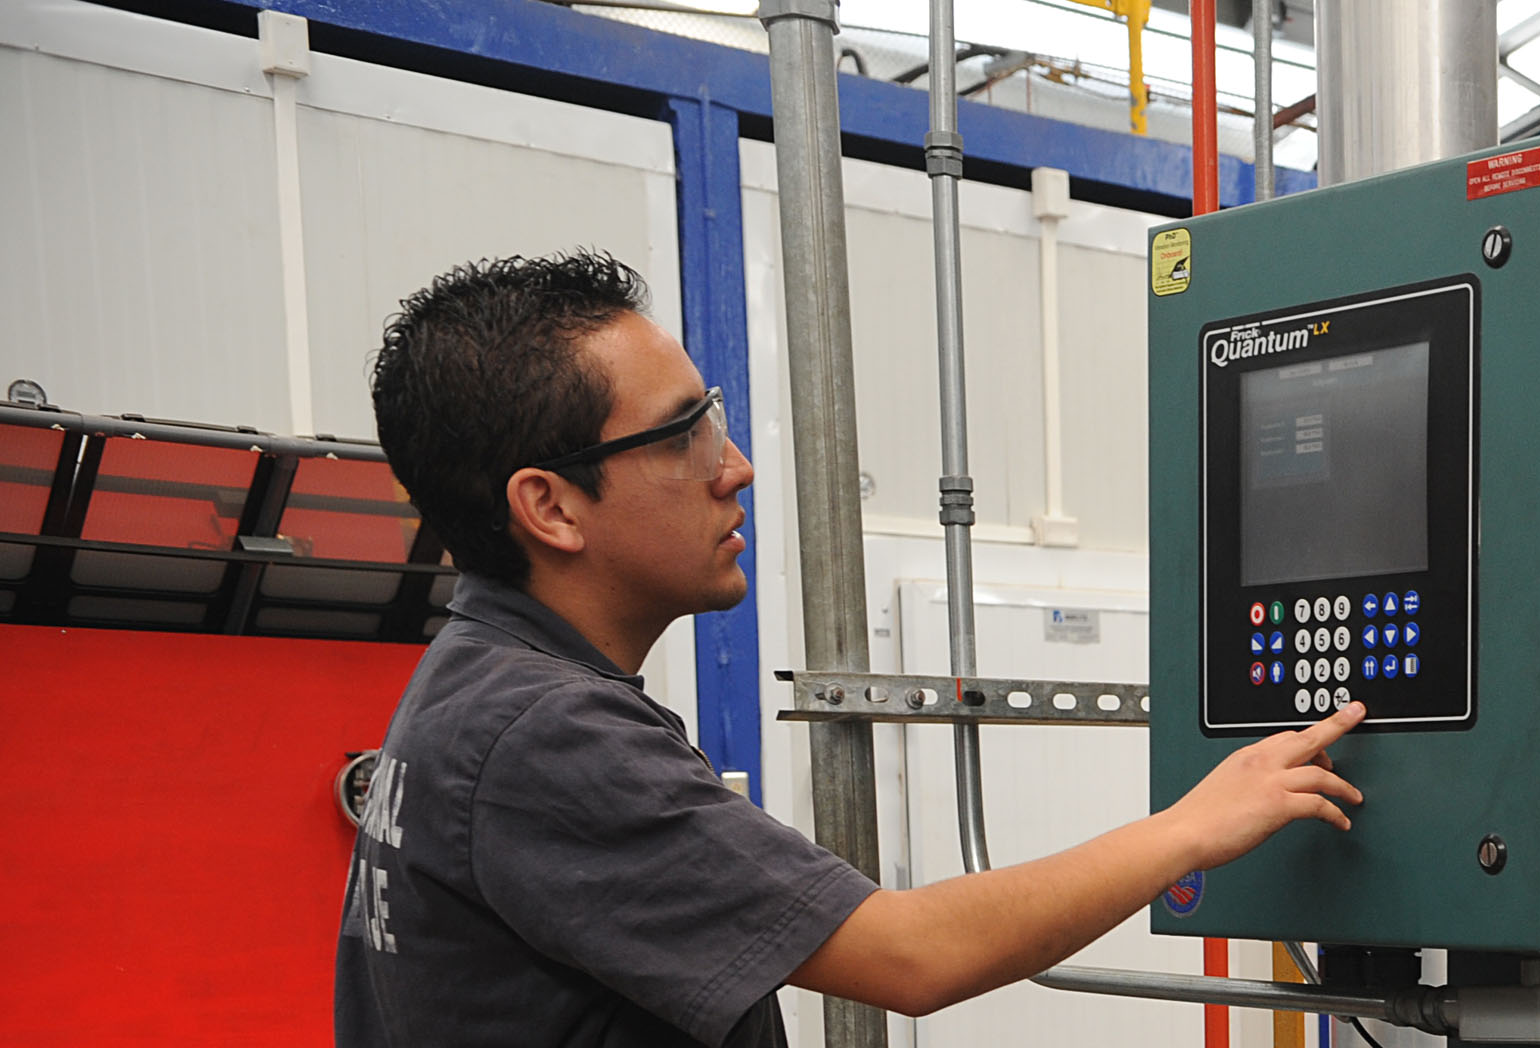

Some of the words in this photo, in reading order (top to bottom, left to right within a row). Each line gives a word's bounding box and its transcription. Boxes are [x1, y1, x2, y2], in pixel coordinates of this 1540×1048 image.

[1488, 154, 1522, 169] WARNING
[1230, 327, 1261, 341] Frick
[1299, 605, 1305, 617] 7
[1319, 604, 1325, 616] 8
[1339, 602, 1345, 615] 9
[1300, 635, 1305, 647] 4
[1319, 634, 1325, 647] 5
[1339, 633, 1345, 645] 6
[1299, 665, 1305, 677] 1
[1319, 664, 1325, 677] 2
[1339, 663, 1345, 676] 3
[1319, 694, 1325, 707] 0
